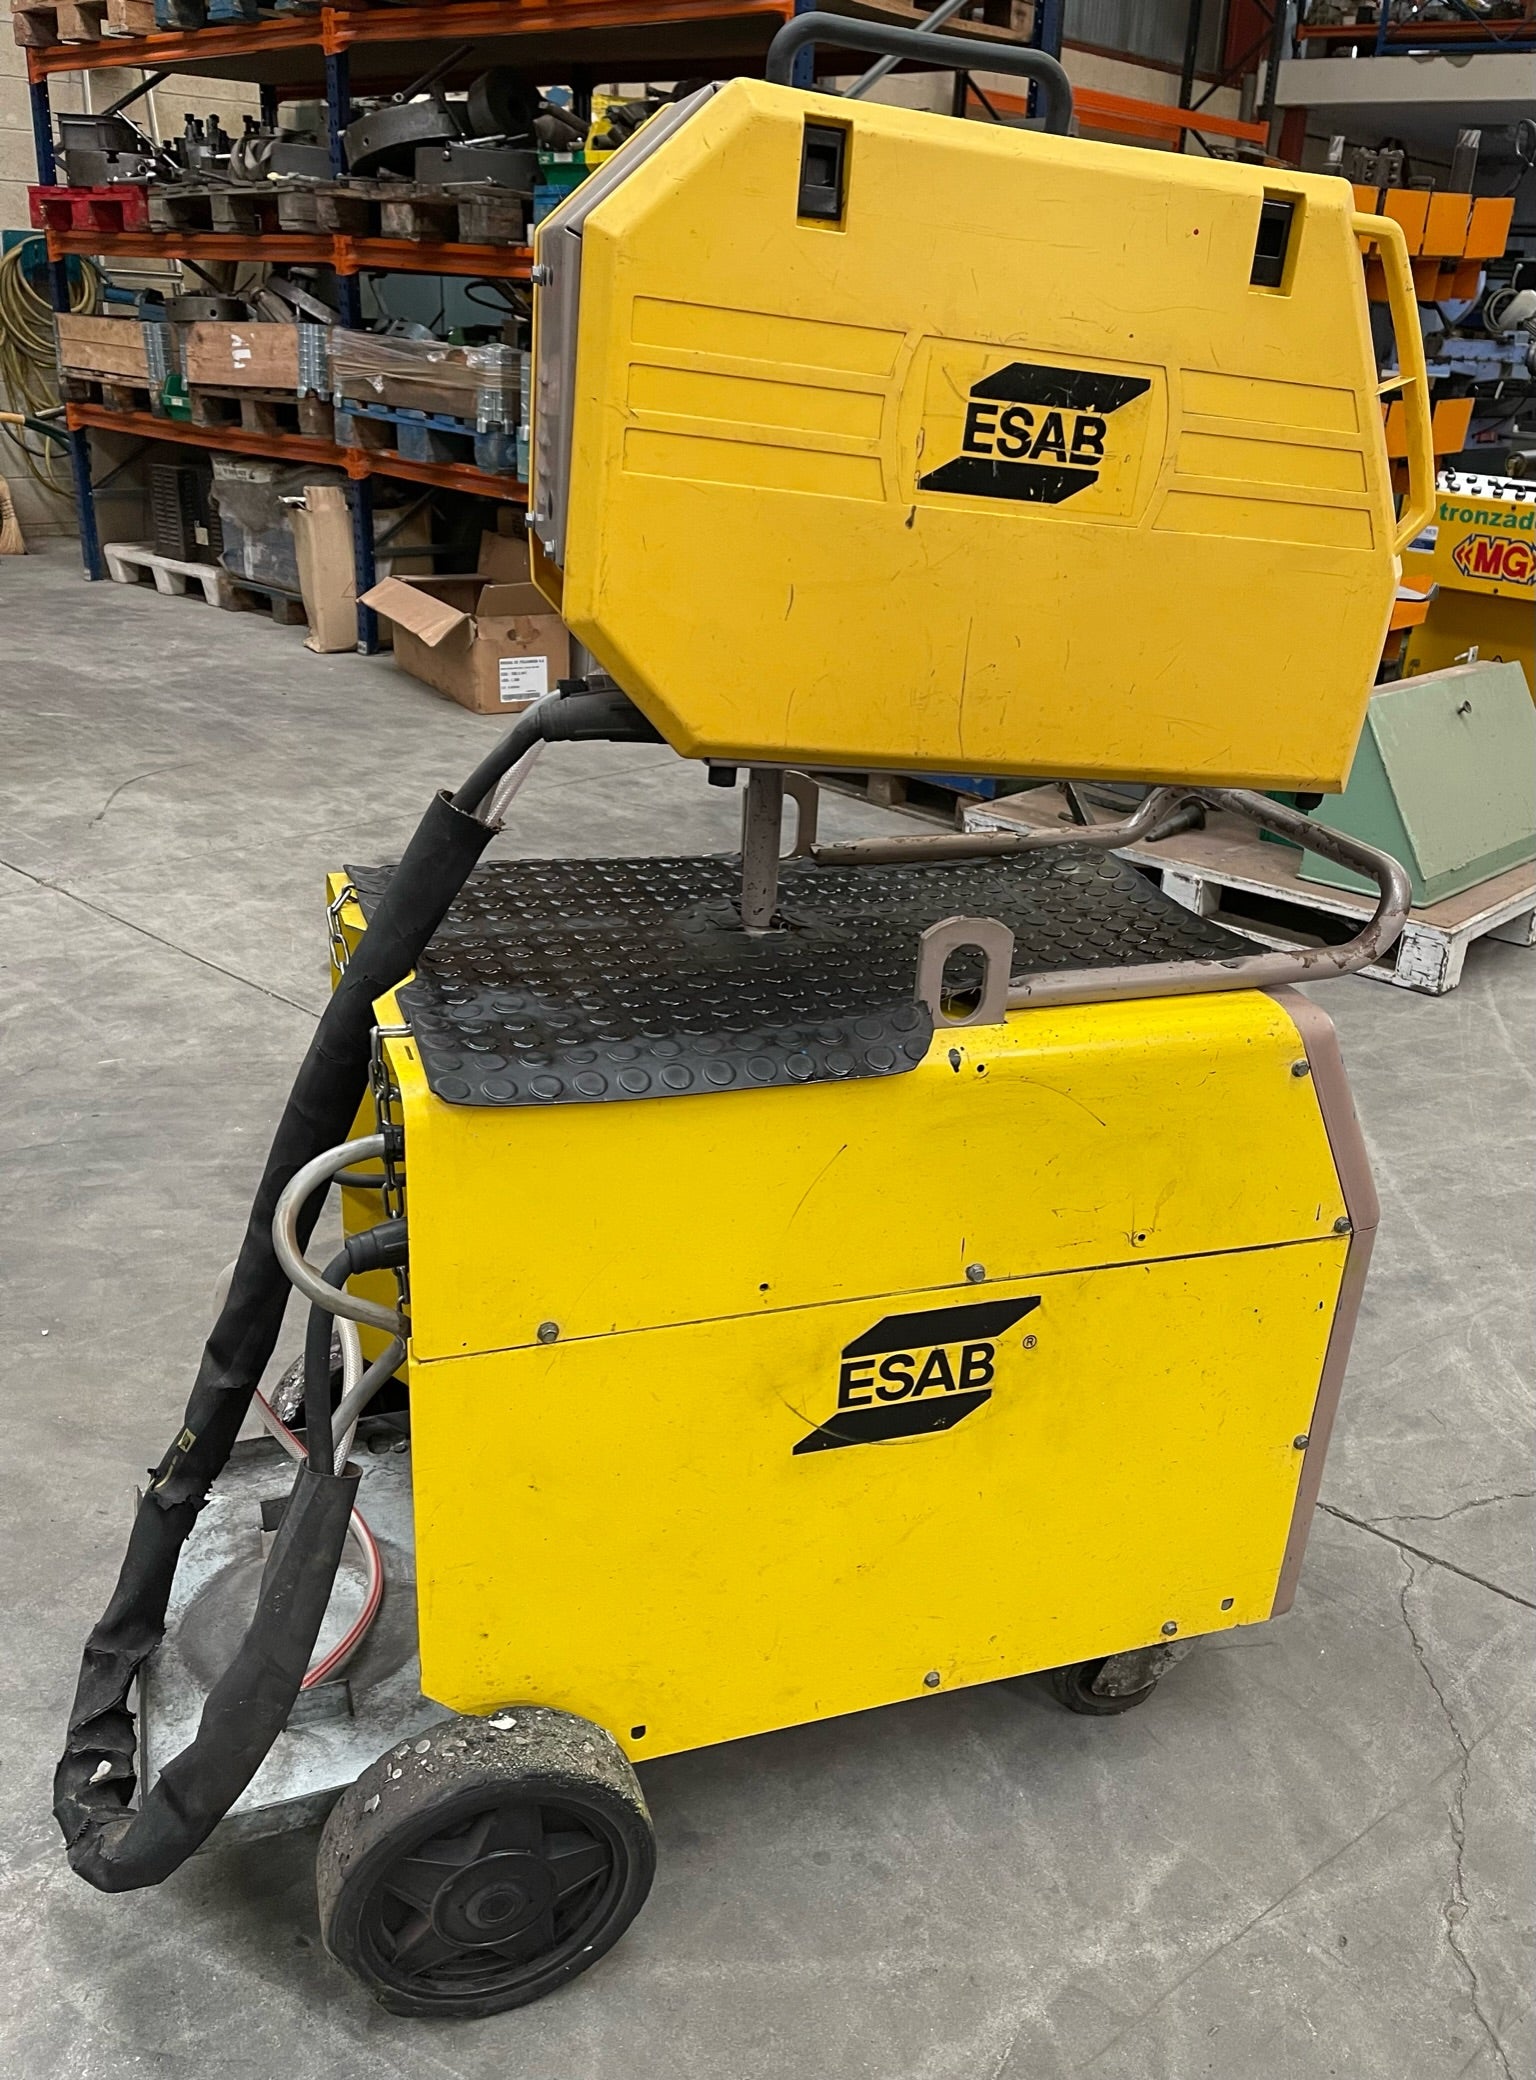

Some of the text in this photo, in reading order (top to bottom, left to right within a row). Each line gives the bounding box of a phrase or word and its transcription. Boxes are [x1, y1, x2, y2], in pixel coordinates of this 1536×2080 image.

[962, 402, 1107, 466] ESAB
[1440, 502, 1536, 530] tronzad
[837, 1342, 996, 1409] ESAB
